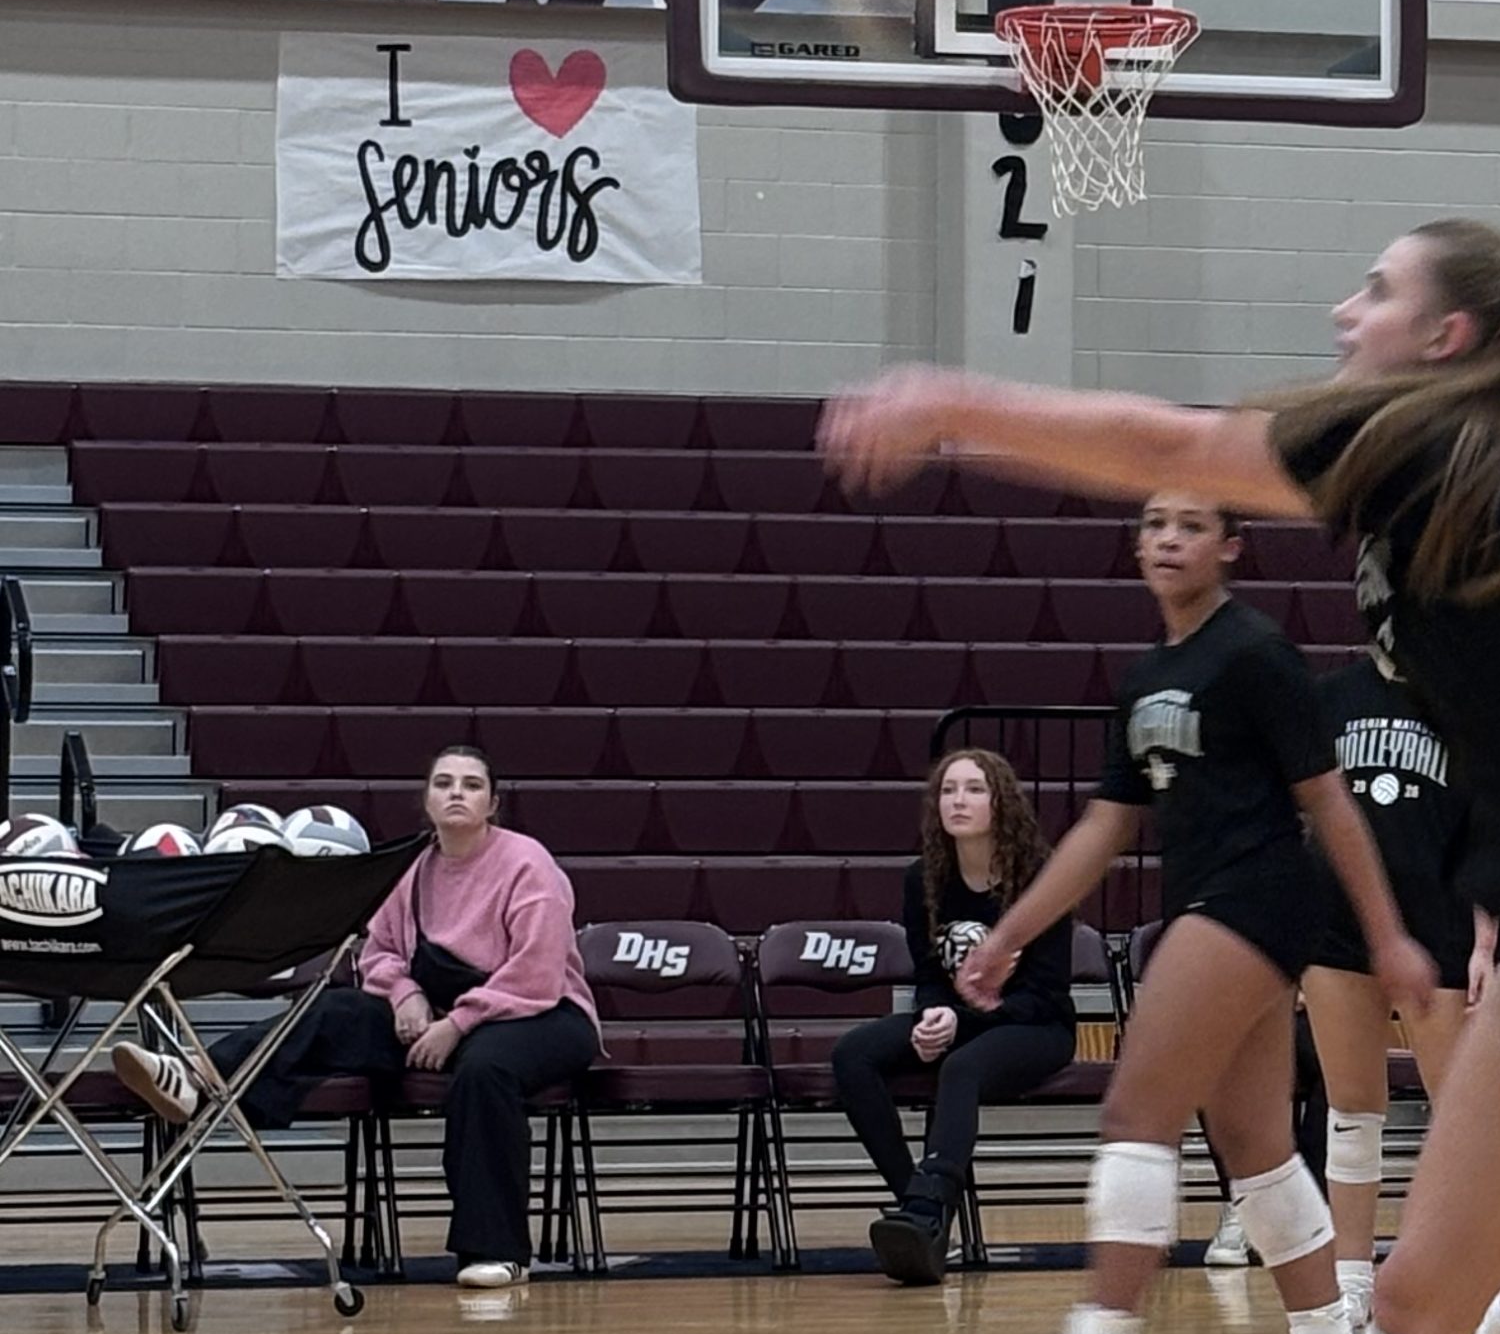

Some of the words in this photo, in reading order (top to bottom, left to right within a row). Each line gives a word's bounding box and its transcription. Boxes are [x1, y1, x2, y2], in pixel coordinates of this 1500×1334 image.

[778, 42, 861, 58] GARED
[376, 43, 412, 127] I
[1335, 729, 1449, 788] VOLLEYBALL
[612, 932, 691, 978] DHS
[799, 931, 879, 976] DHS
